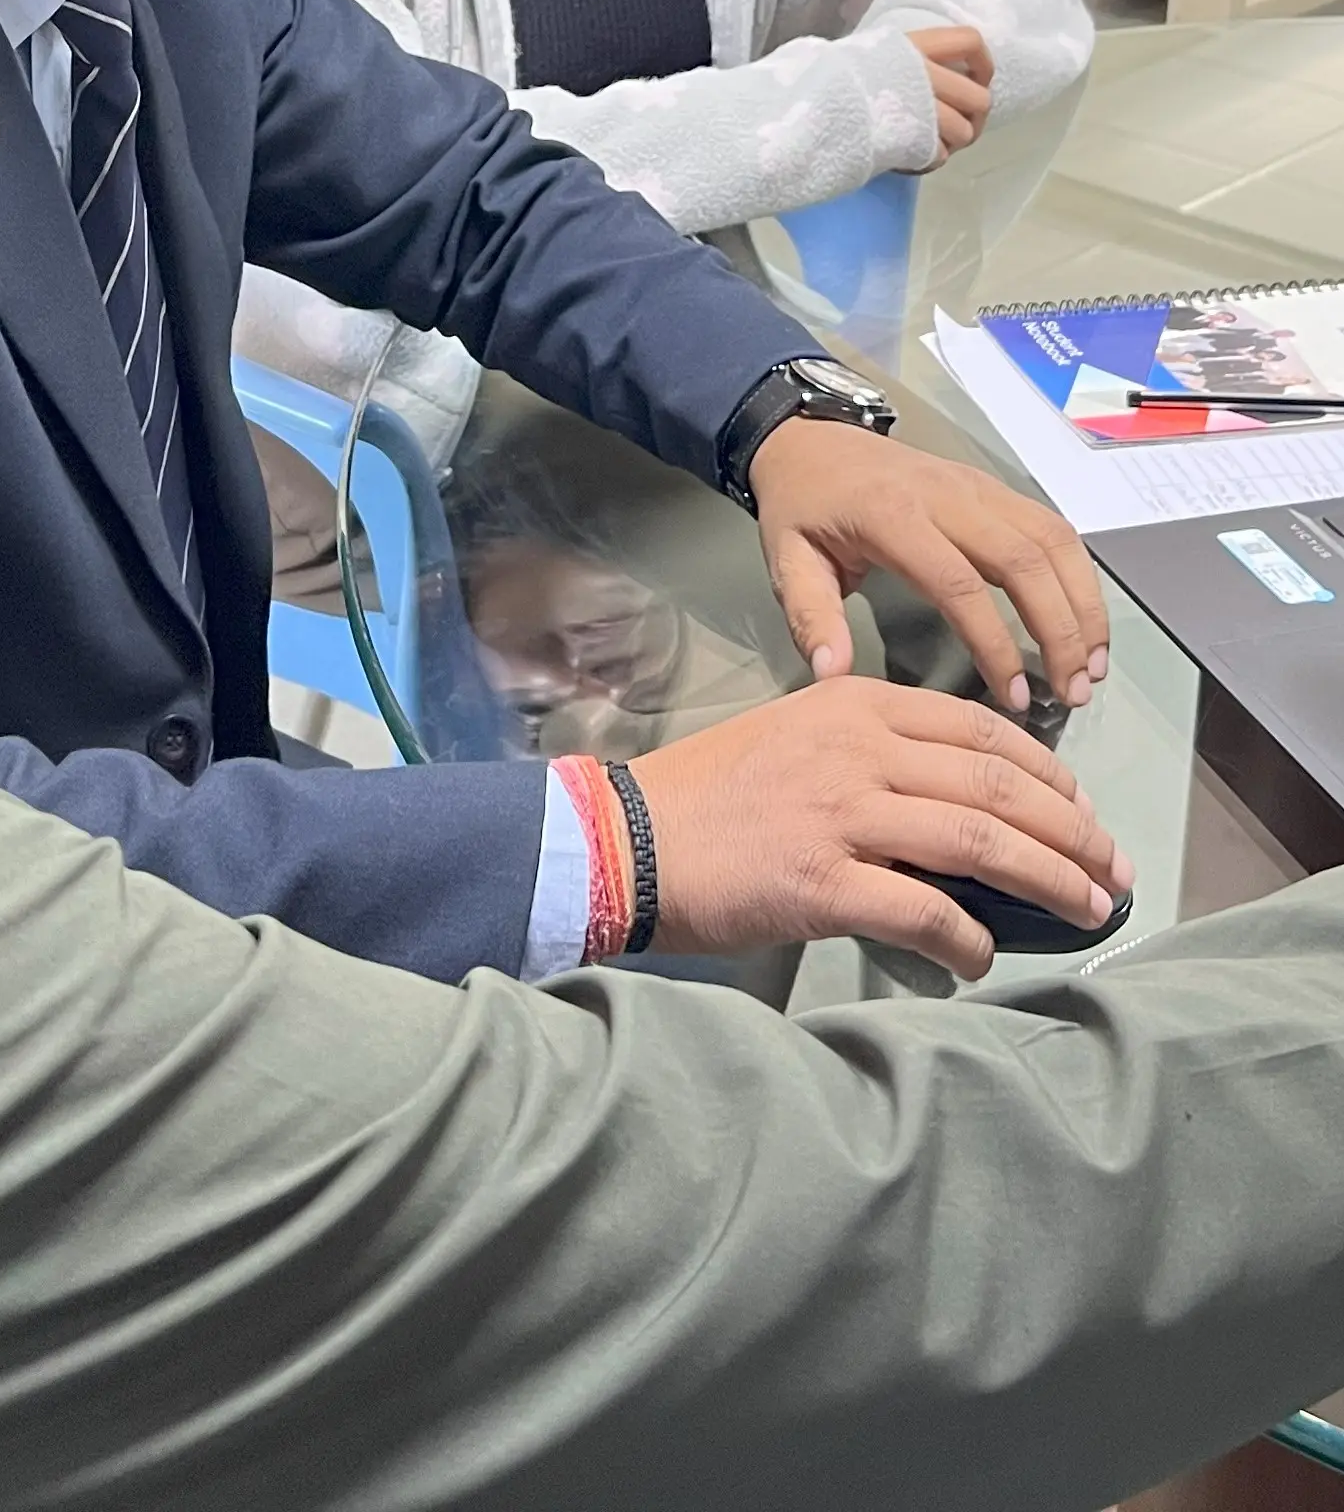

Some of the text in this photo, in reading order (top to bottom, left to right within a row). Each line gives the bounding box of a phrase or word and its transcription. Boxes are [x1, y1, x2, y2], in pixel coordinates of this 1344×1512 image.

[1022, 321, 1072, 366] Notebook
[1041, 320, 1084, 357] Student
[1289, 523, 1332, 559] VICTUS
